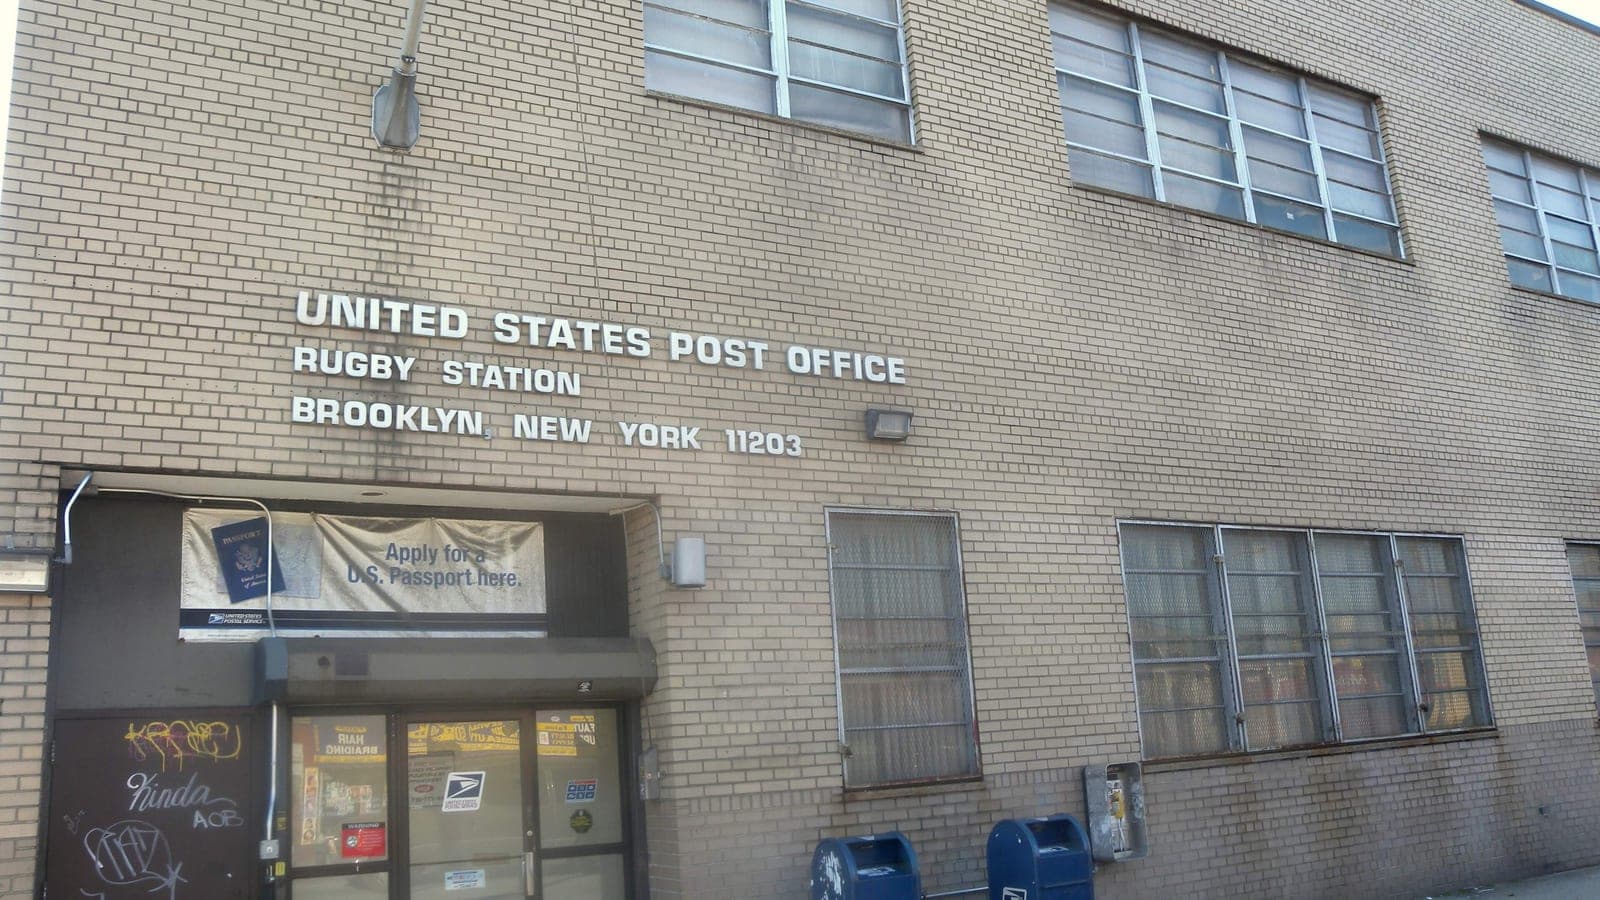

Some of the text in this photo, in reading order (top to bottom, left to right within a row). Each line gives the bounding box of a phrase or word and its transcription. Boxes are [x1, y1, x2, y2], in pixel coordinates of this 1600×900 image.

[296, 291, 906, 385] UNITED STATES POST OFFICE
[293, 347, 581, 396] RUGBY STATION
[291, 396, 802, 457] BROOKLYN, NEW YORK 11203
[347, 564, 522, 589] U.S. Passport here.
[385, 542, 485, 565] Apply for a
